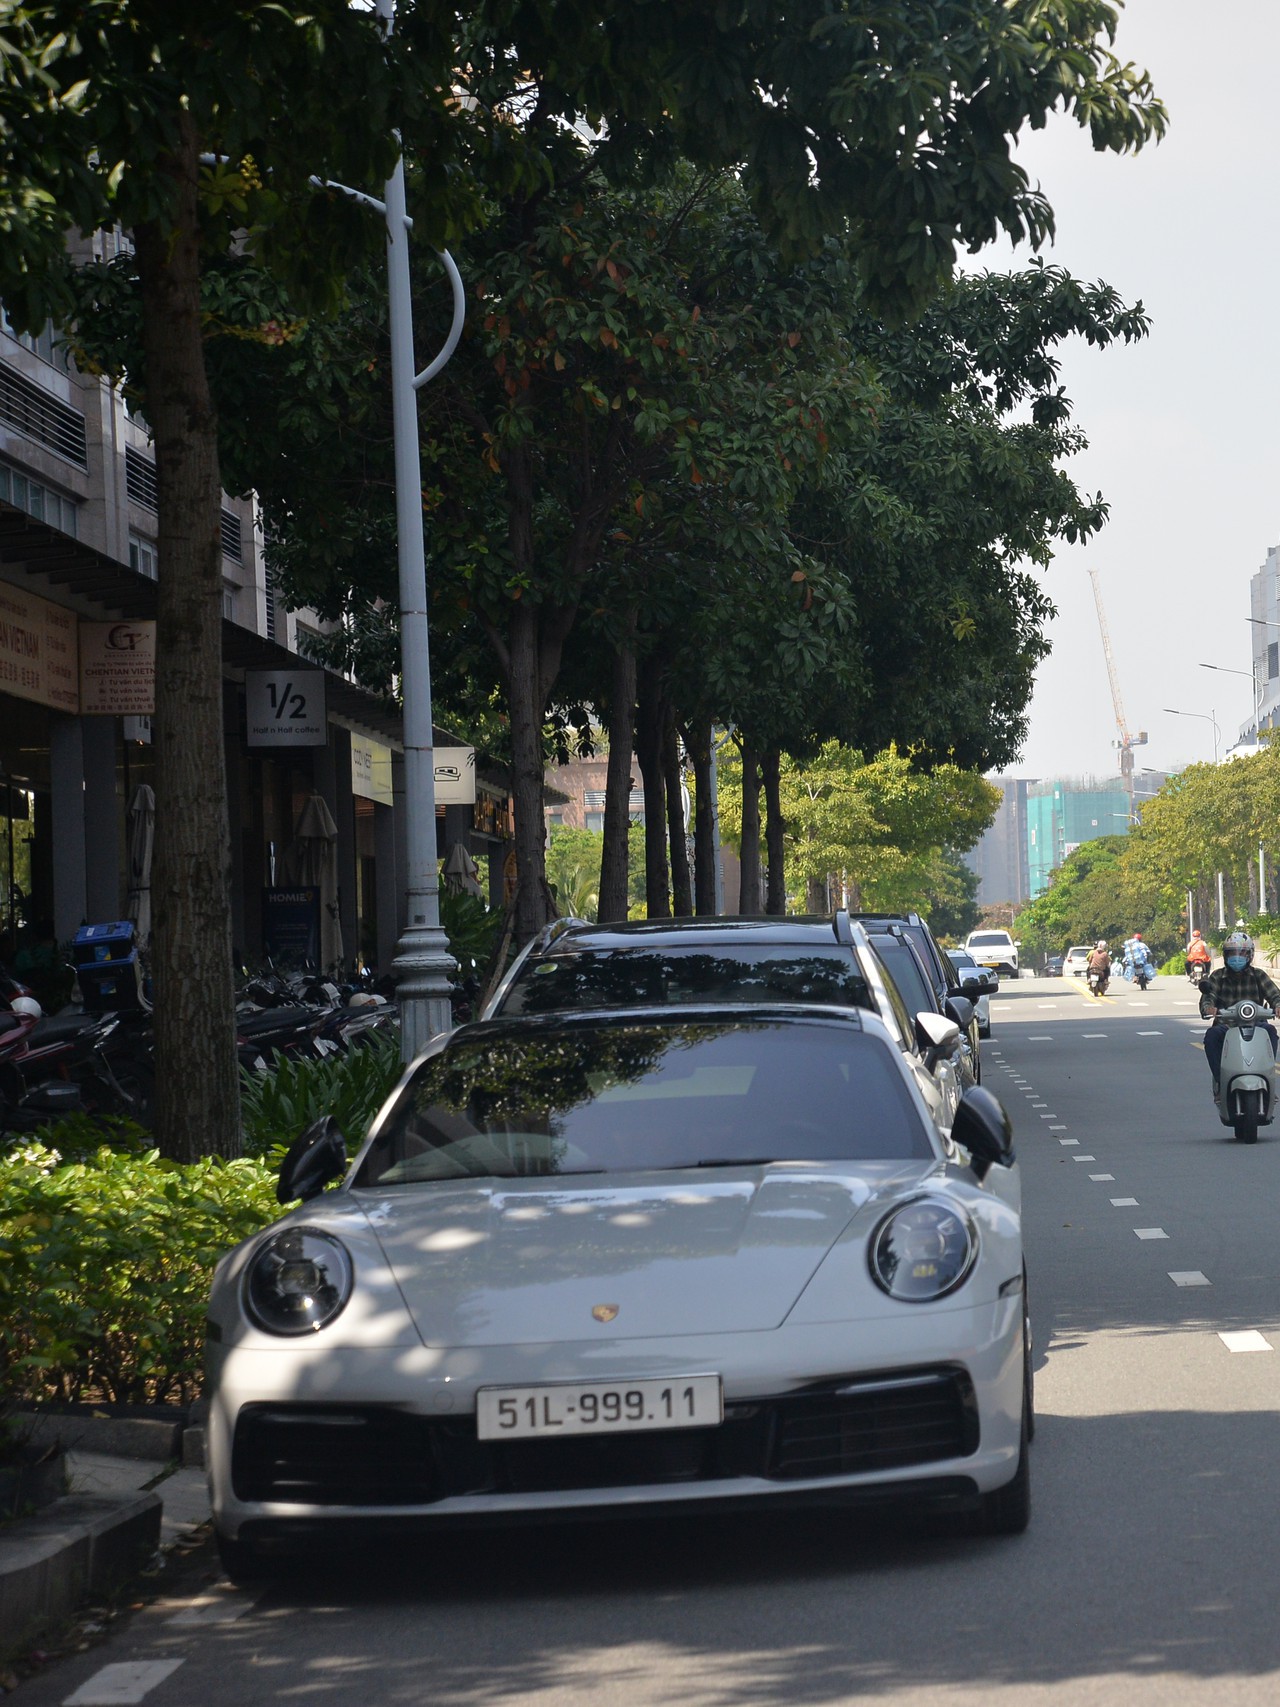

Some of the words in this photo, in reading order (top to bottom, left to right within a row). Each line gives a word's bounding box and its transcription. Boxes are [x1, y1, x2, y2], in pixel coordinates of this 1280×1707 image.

[85, 668, 129, 676] CHENTIAN
[253, 727, 269, 735] Half
[269, 893, 307, 903] HOMIE
[498, 1386, 695, 1429] 51L-999.11
